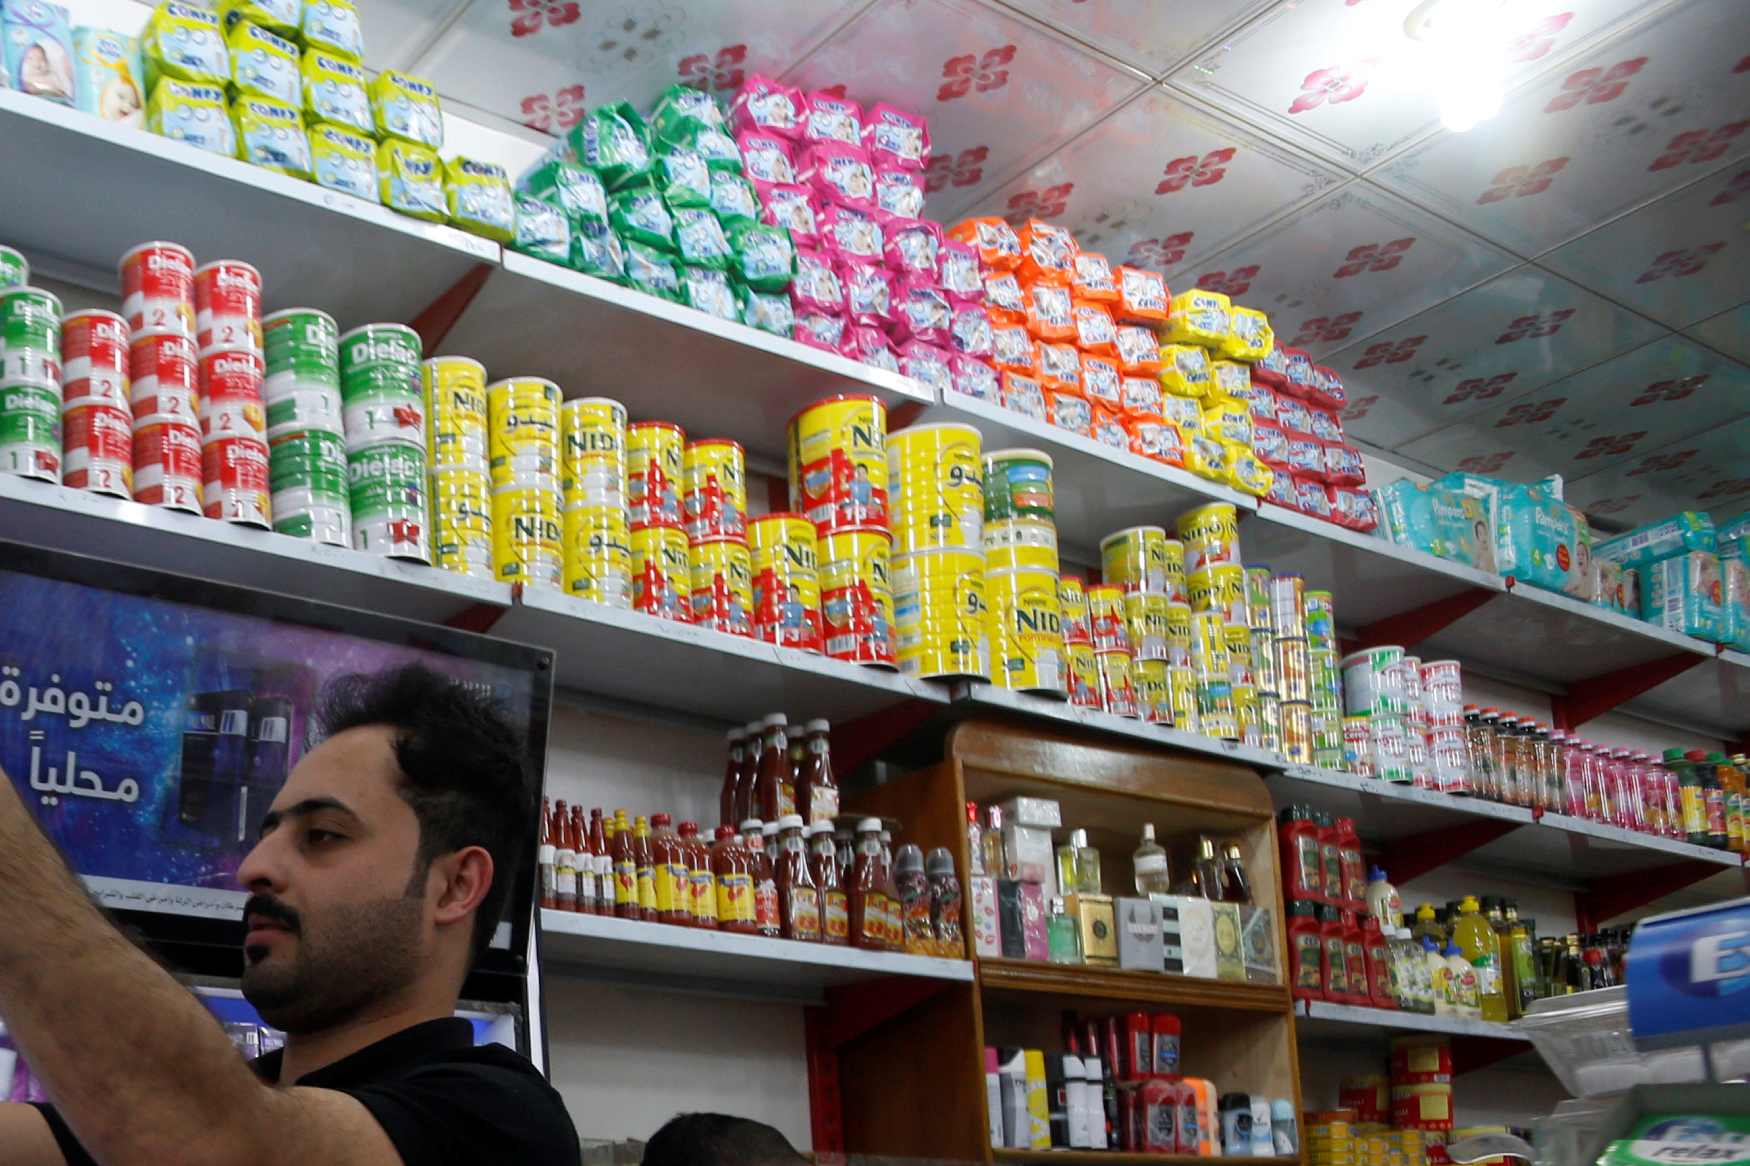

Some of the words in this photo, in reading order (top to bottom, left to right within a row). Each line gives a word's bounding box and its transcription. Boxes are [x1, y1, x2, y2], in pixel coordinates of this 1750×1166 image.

[453, 390, 487, 413] NID
[566, 431, 627, 456] NID
[1535, 506, 1570, 535] Pampers
[662, 546, 688, 570] NID
[782, 544, 817, 572] NID
[1016, 609, 1059, 635] NID
[1169, 621, 1191, 636] NID
[1226, 640, 1250, 655] NID
[29, 730, 139, 806] محلياً
[1655, 1143, 1739, 1162] relax
